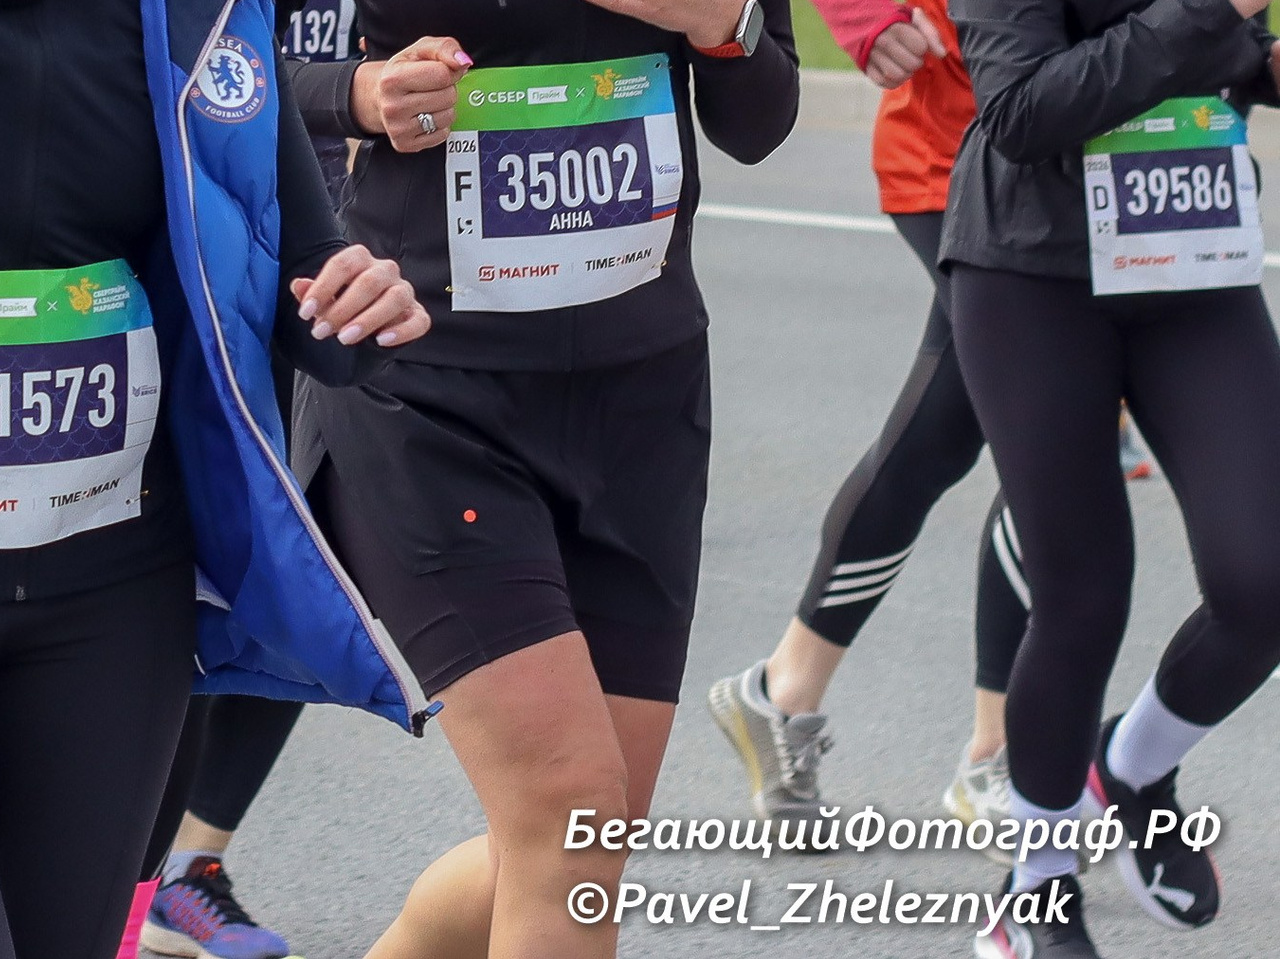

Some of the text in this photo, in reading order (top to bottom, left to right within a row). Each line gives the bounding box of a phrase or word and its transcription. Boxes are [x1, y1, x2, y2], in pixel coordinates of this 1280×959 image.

[282, 10, 337, 54] 132
[205, 97, 260, 118] FOOTBALL CLUB
[487, 91, 525, 103] СБЕР
[448, 140, 476, 154] 2026
[455, 171, 472, 202] F
[497, 143, 642, 212] 35002
[1093, 185, 1108, 211] D
[1124, 163, 1233, 216] 39586
[549, 210, 593, 231] АННА
[499, 264, 559, 279] МАГНИТ
